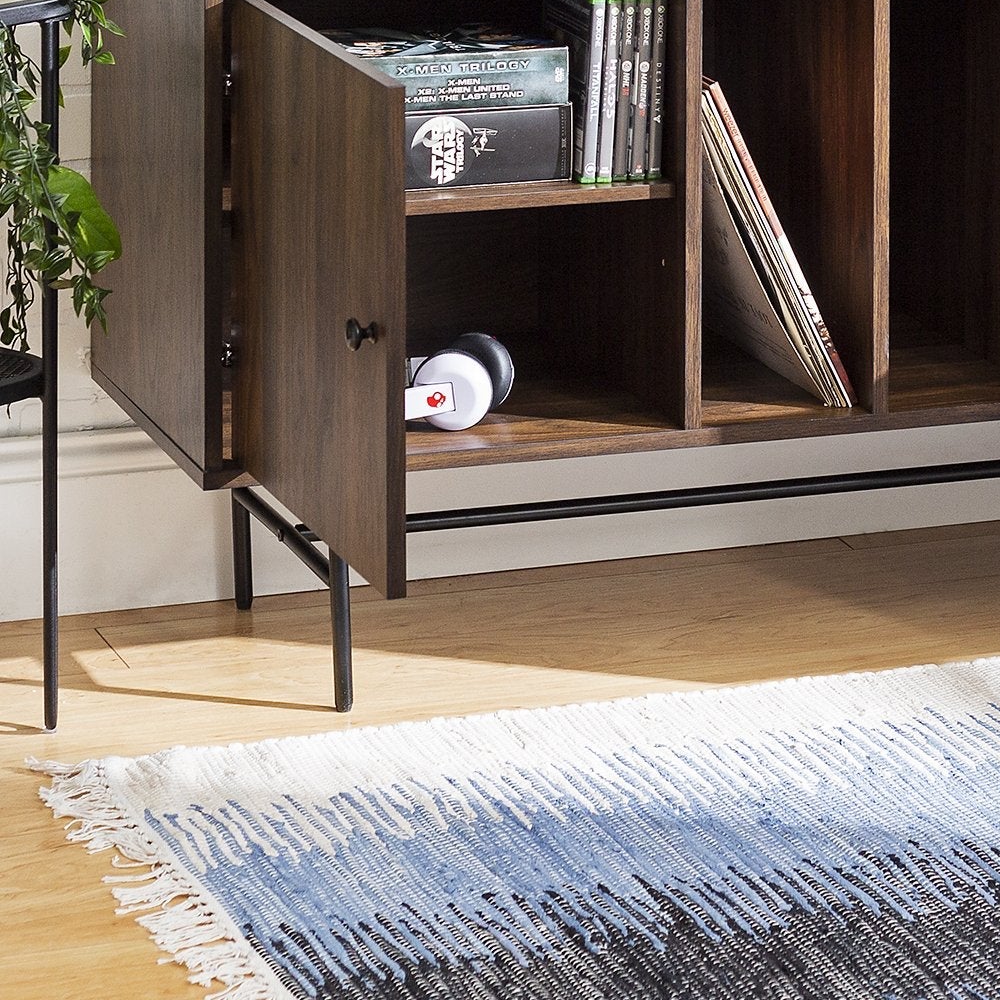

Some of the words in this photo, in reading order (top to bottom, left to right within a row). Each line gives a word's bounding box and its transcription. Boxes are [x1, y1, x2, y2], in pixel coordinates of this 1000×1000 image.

[396, 63, 453, 77] X-MEN
[459, 60, 531, 73] TRILOGY
[447, 77, 481, 87] X-MEN
[607, 58, 618, 108] HALO
[622, 71, 631, 88] NHL
[639, 71, 648, 106] MADDEN
[654, 62, 663, 112] DESTINY
[404, 95, 437, 104] X-MEN
[438, 93, 460, 102] THE
[461, 92, 488, 101] LAST
[489, 90, 524, 99] STAND
[438, 85, 471, 95] X-MEN
[473, 83, 511, 92] UNITED
[590, 61, 602, 121] TITANFALL
[430, 121, 444, 185] STAR
[443, 120, 456, 184] WARS
[456, 128, 466, 174] TRILOGY
